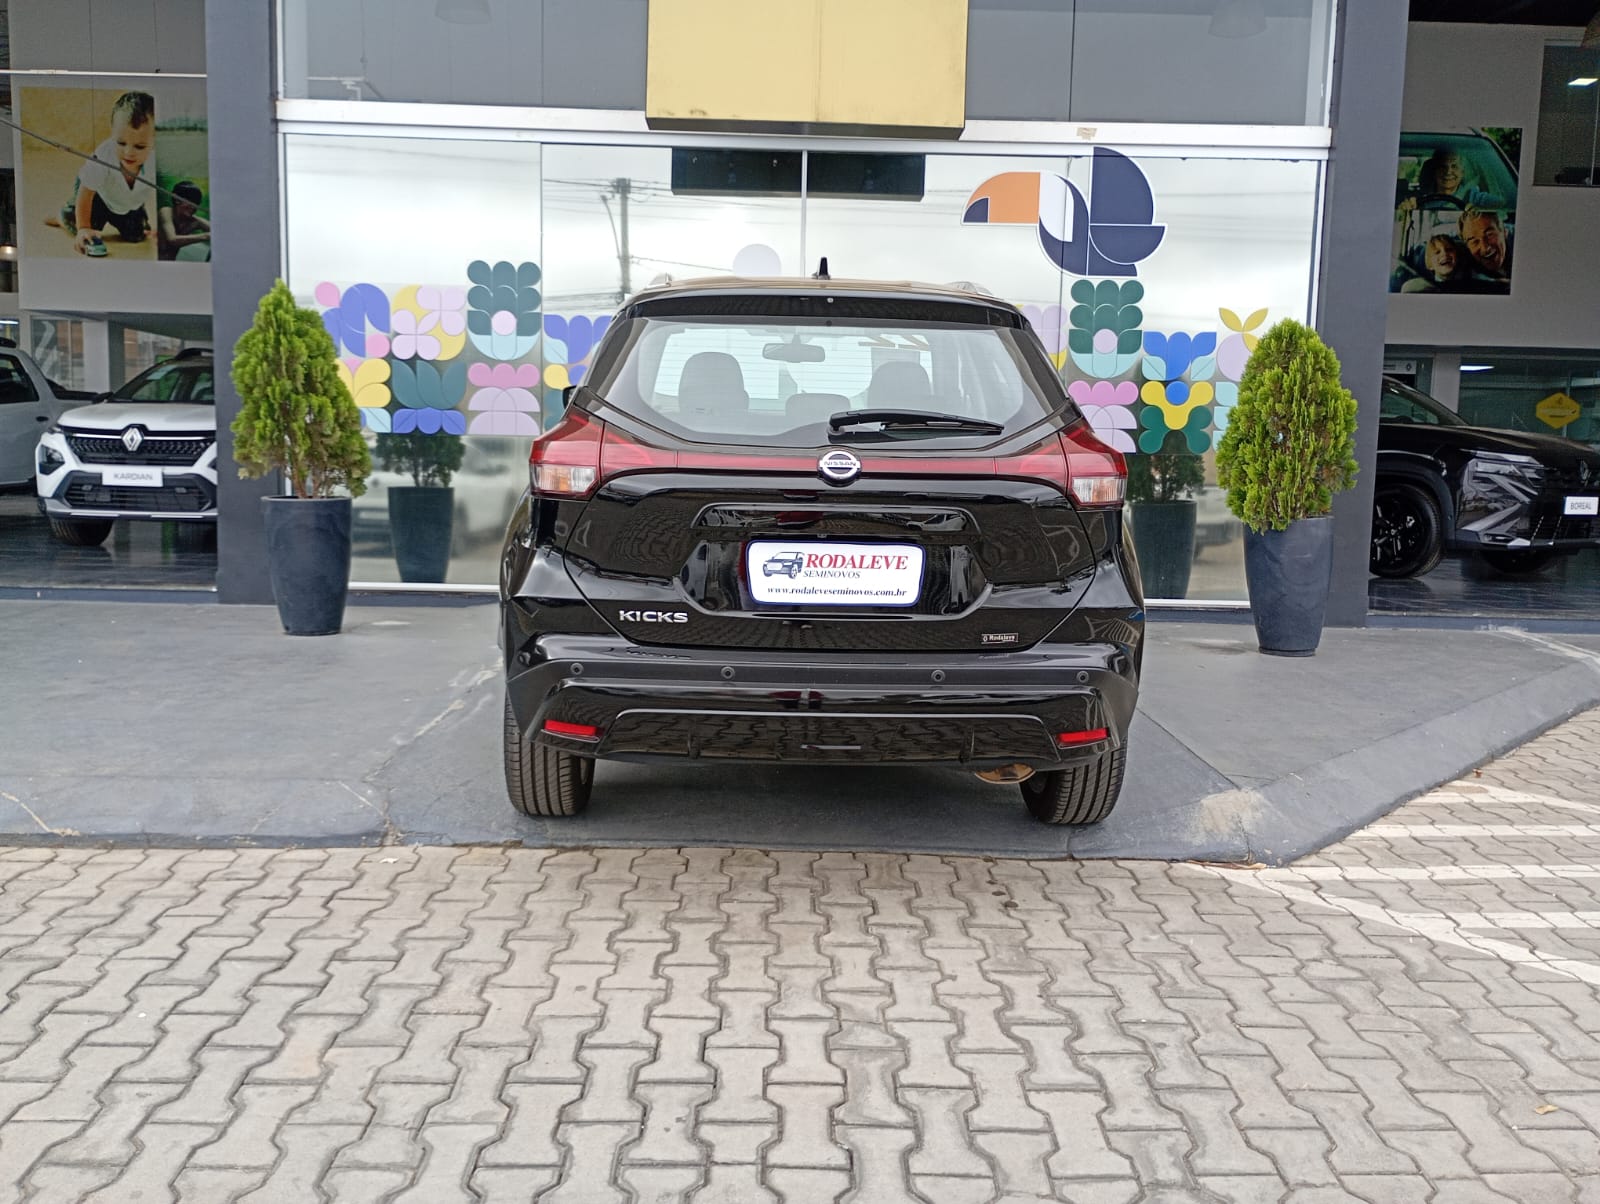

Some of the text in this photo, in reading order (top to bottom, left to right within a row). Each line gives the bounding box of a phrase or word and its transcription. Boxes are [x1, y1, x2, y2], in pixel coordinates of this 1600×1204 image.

[113, 472, 154, 480] KARDIAN
[1570, 502, 1592, 510] BOREAL
[806, 553, 909, 570] RODALEVE
[802, 570, 861, 579] SEMINOVOS
[767, 586, 908, 597] www.rodaleveseminovos.com.br
[618, 610, 689, 623] KICKS
